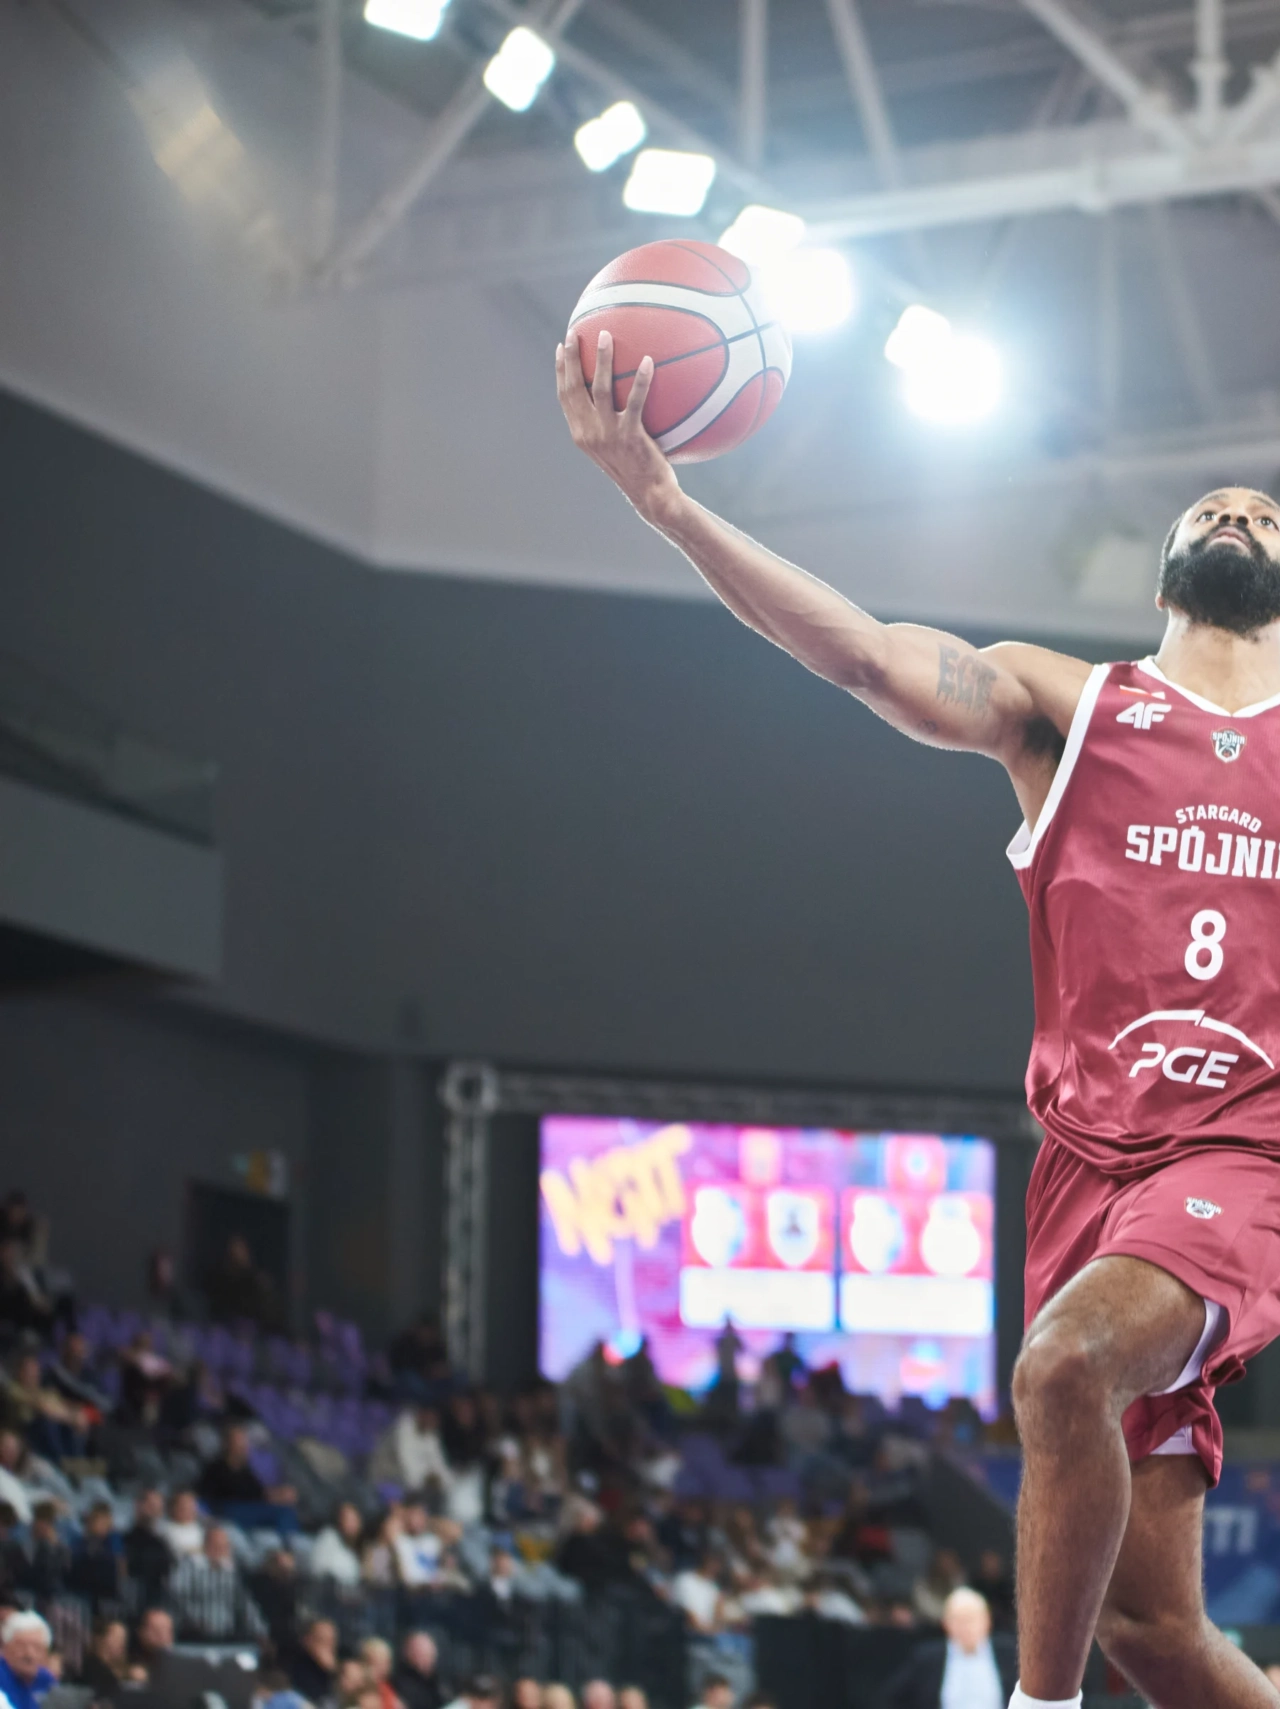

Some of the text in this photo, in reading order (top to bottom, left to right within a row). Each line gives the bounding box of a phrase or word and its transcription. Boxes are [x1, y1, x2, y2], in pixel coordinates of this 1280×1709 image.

[1116, 701, 1172, 730] 4F
[1175, 804, 1262, 834] STARGARD
[1184, 909, 1227, 980] 8
[1128, 1042, 1239, 1089] PGE
